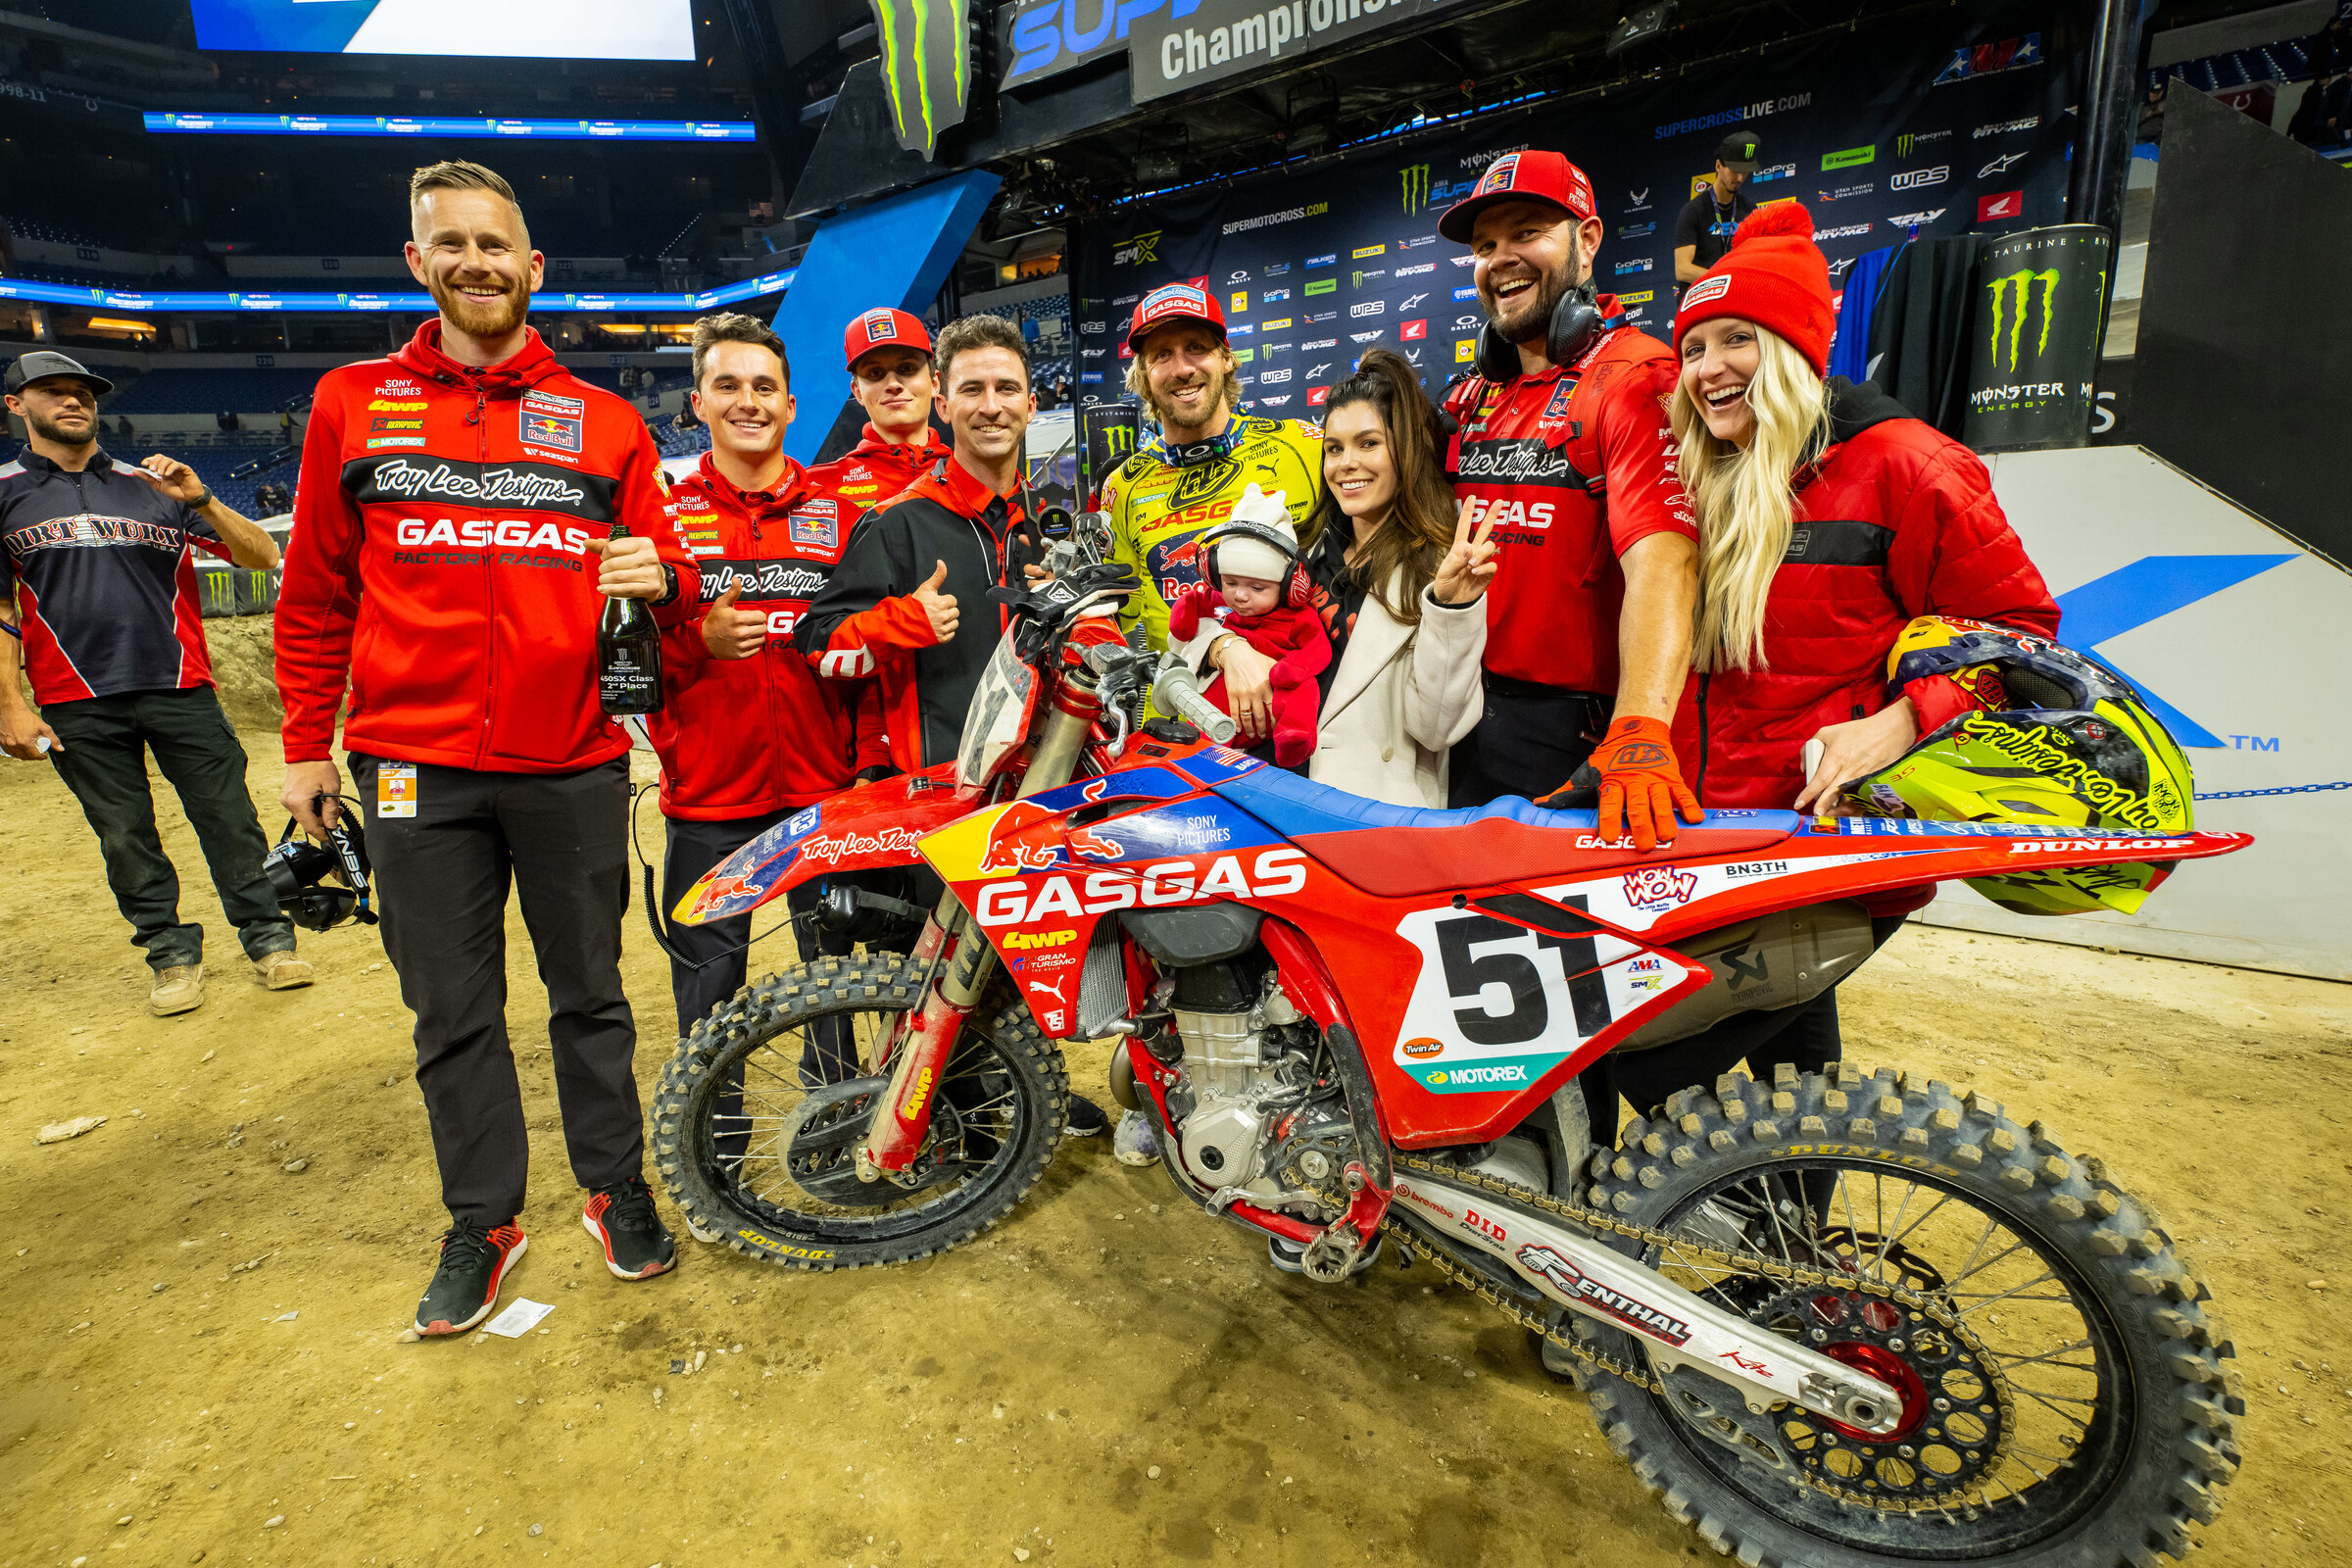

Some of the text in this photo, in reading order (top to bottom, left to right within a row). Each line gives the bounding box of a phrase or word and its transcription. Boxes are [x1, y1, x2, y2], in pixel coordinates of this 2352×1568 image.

[1655, 92, 1811, 140] SUPERCROSSLIVE.COM
[1835, 151, 1871, 164] Kawasaki
[1890, 165, 1950, 191] WPS
[1835, 188, 1873, 199] COMMISSION
[1222, 201, 1328, 235] SUPERMOTOCROSS.COM
[1113, 236, 1159, 266] SMX
[1354, 247, 1383, 257] SUZUKI
[1994, 237, 2068, 259] TAURINE
[1615, 259, 1653, 269] GoPro
[1264, 288, 1290, 297] GoPro
[1148, 300, 1200, 318] GASGAS
[1350, 300, 1385, 318] WPS
[385, 379, 413, 388] SONY
[1261, 368, 1292, 384] WPS
[374, 387, 421, 396] PICTURES
[1971, 381, 2065, 406] MONSTER
[525, 401, 580, 415] GASGAS
[1978, 400, 2047, 414] ENERGY
[380, 437, 423, 447] MOTOREX
[527, 429, 574, 448] Red Bull
[1250, 440, 1269, 454] SONY
[538, 451, 579, 464] seaspan
[843, 471, 873, 483] PICTURES
[849, 465, 865, 475] SONY
[374, 459, 585, 507] Troy Lee Designs
[674, 501, 710, 512] PICTURES
[680, 495, 702, 504] SONY
[3, 519, 78, 555] DIRT
[87, 518, 180, 548] WURX
[397, 518, 590, 556] GASGAS
[797, 531, 832, 544] Red Bull
[153, 543, 179, 554] U.S.A.
[807, 547, 835, 557] seaspan
[393, 552, 583, 572] FACTORY RACING
[2229, 735, 2280, 753] TM
[1187, 814, 1218, 830] SONY
[1177, 827, 1231, 847] PICTURES
[802, 832, 878, 865] Troy Lee
[2009, 839, 2195, 854] DUNLOP
[331, 829, 368, 889] SENA
[1726, 861, 1788, 875] BN3TH
[1624, 864, 1675, 889] WOW
[975, 848, 1307, 927] GASGAS
[1030, 957, 1076, 968] TURISMO
[1037, 953, 1067, 962] GRAN
[1435, 894, 1614, 1046] 51
[1627, 958, 1662, 973] AMA
[1630, 977, 1663, 991] SMX
[1404, 1042, 1443, 1054] Twin Air
[1449, 1064, 1528, 1084] MOTOREX
[1788, 1144, 1960, 1176] DUNLOP
[1411, 1191, 1454, 1219] brembo
[738, 1229, 826, 1260] DUNLOP
